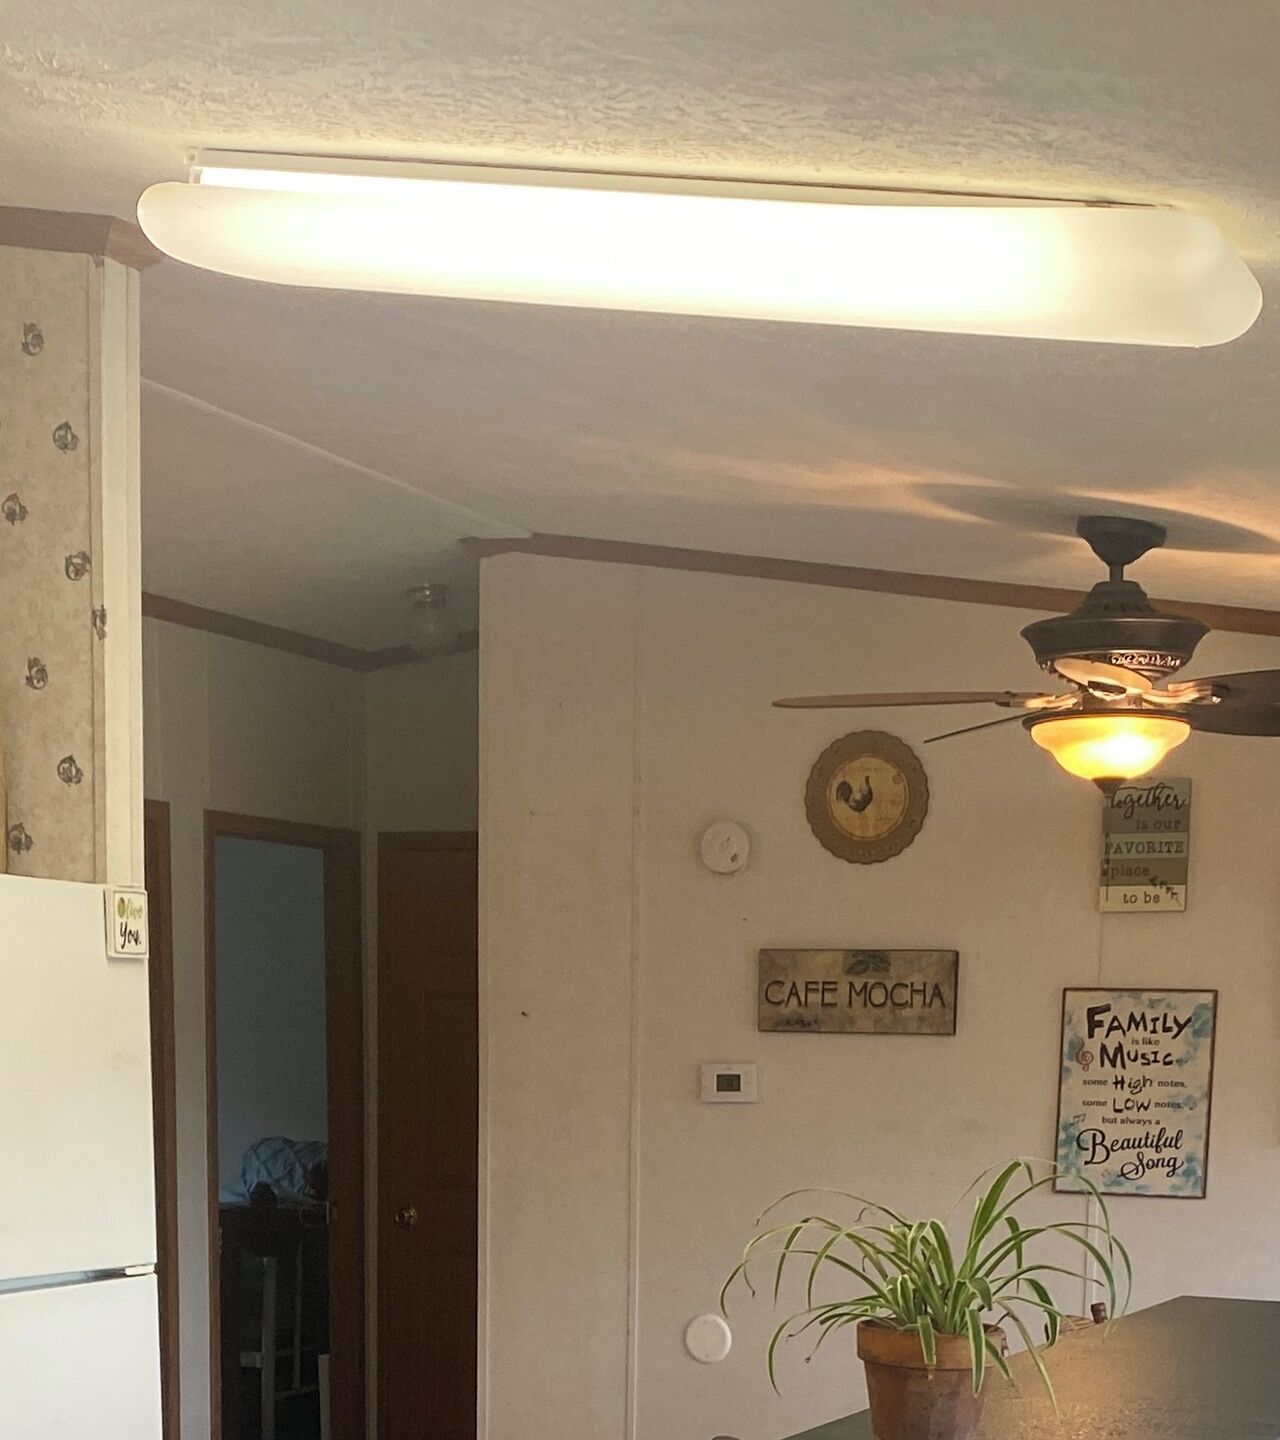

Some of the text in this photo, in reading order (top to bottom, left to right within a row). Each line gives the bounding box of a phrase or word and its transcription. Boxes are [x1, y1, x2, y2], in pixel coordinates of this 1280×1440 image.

[1154, 820, 1182, 831] our
[1104, 840, 1185, 855] FAVORITE
[1110, 864, 1151, 879] place
[1123, 891, 1161, 904] to be
[765, 979, 946, 1009] CAFE MOCHA
[1086, 1003, 1193, 1040] FAMILY
[1131, 1037, 1160, 1045] is like
[1082, 1078, 1109, 1087] some
[1082, 1099, 1108, 1107] some
[1101, 1116, 1117, 1125] but
[1120, 1116, 1152, 1126] always
[1075, 1126, 1184, 1166] Beautiful
[1117, 1151, 1184, 1181] Song
